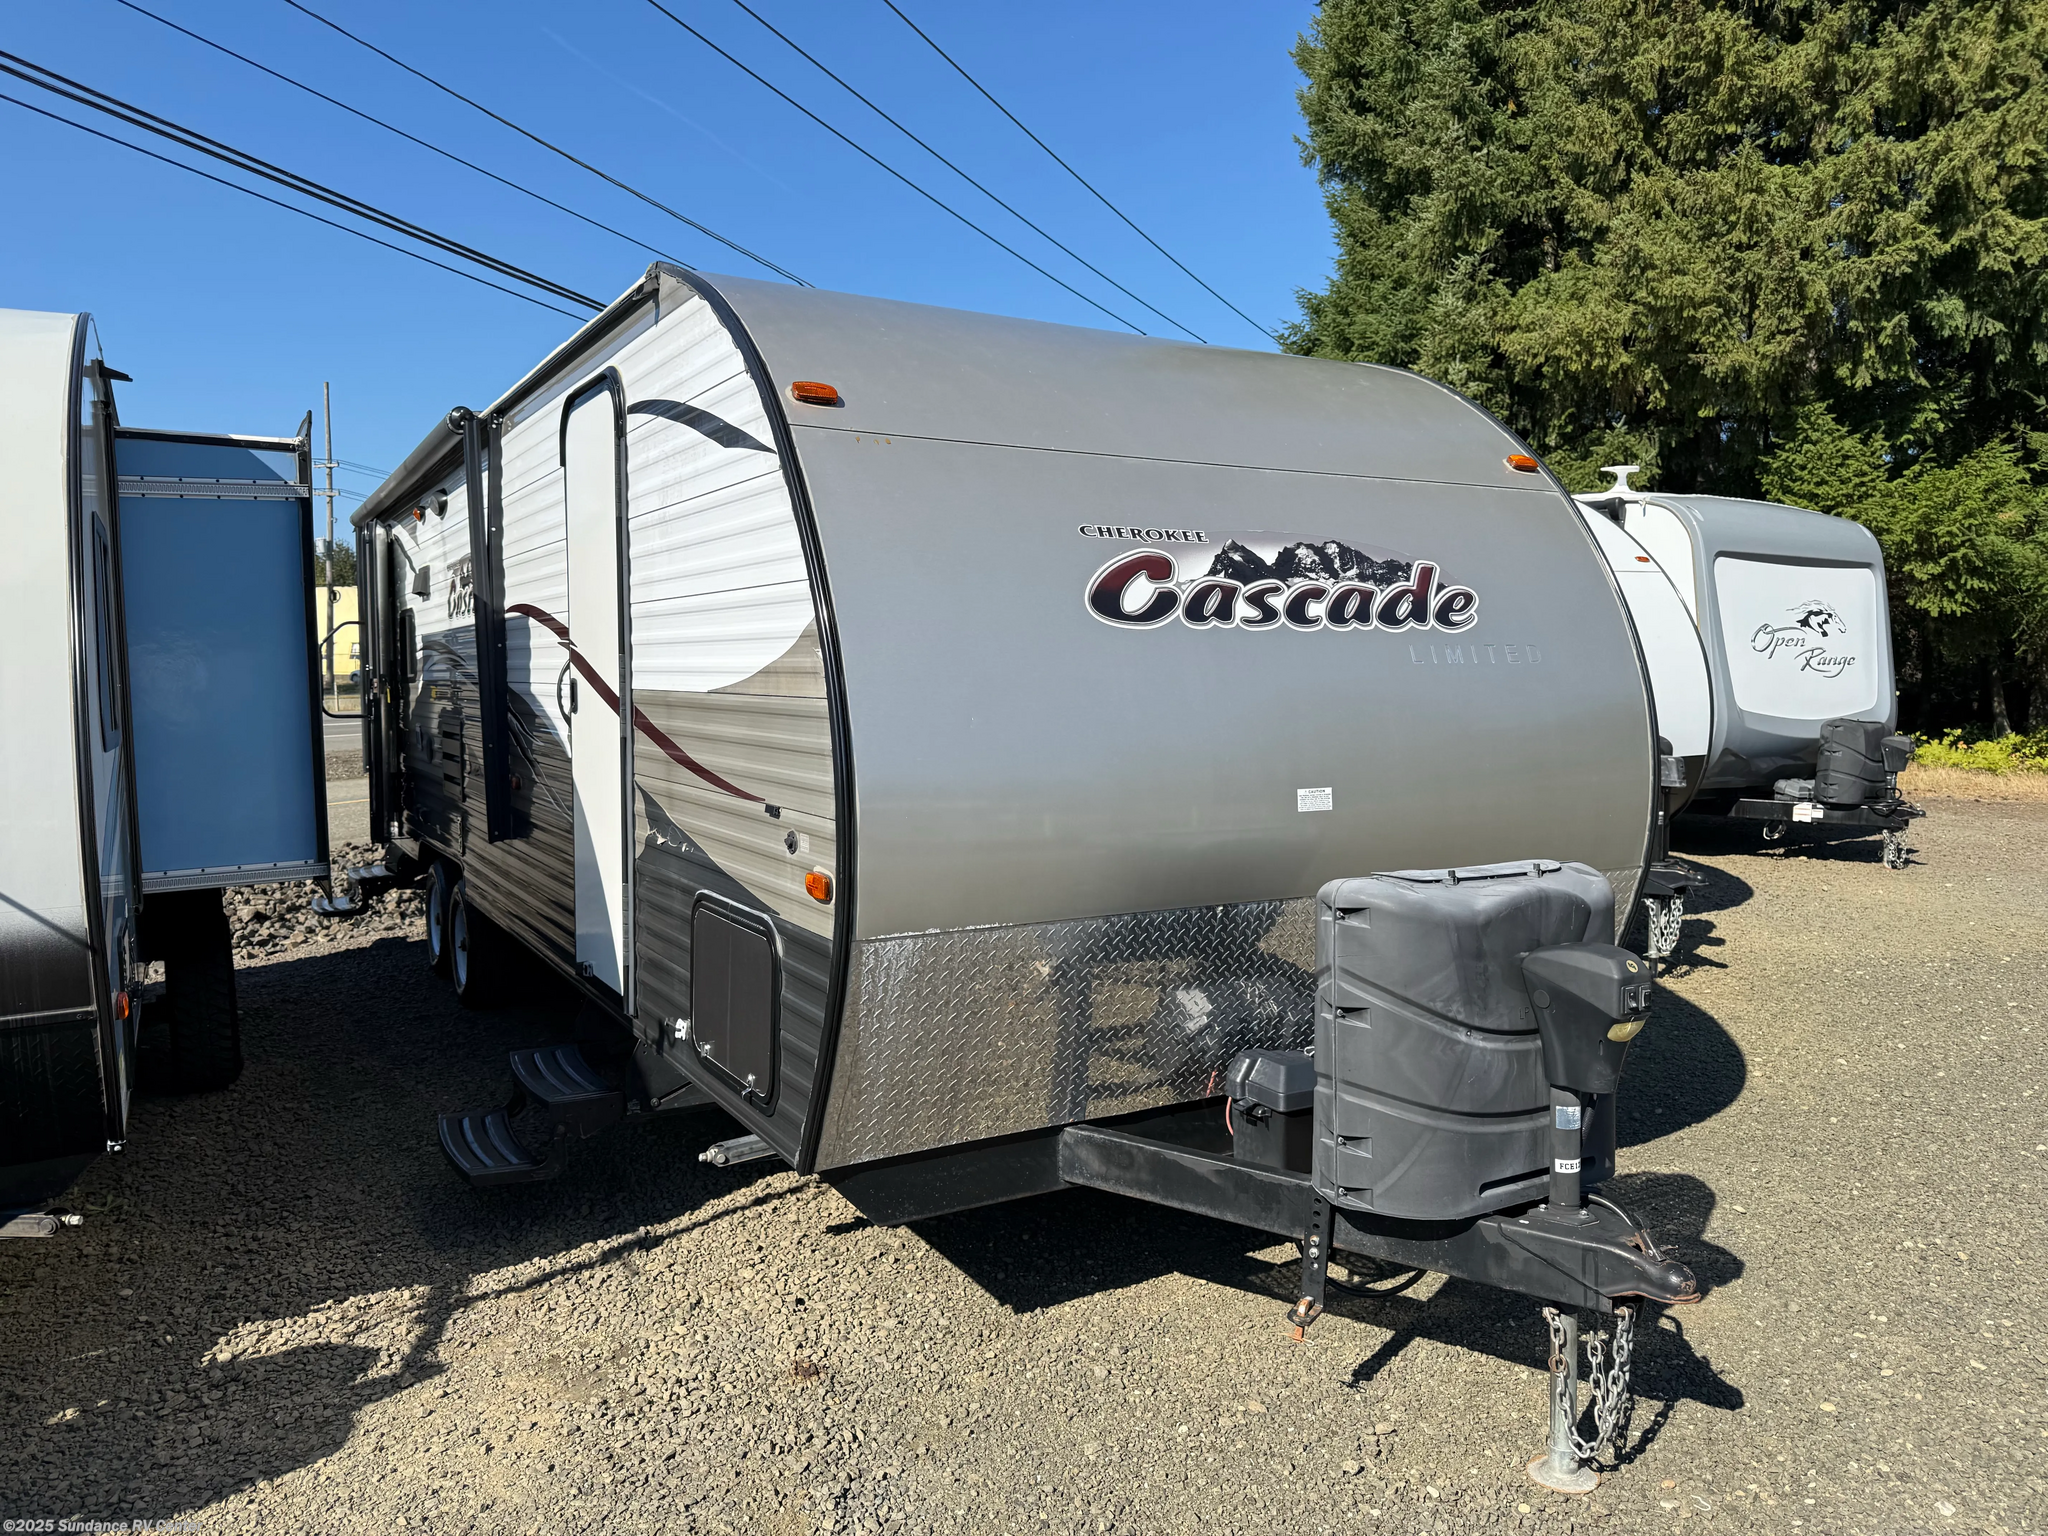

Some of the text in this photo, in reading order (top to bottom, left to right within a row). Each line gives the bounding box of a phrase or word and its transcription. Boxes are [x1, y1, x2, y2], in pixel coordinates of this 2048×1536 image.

[1078, 524, 1210, 544] CHEROKEE
[1085, 548, 1480, 633] Cascade
[1408, 643, 1544, 665] LIMITED
[1751, 623, 1807, 659] Open
[1794, 647, 1856, 678] Range
